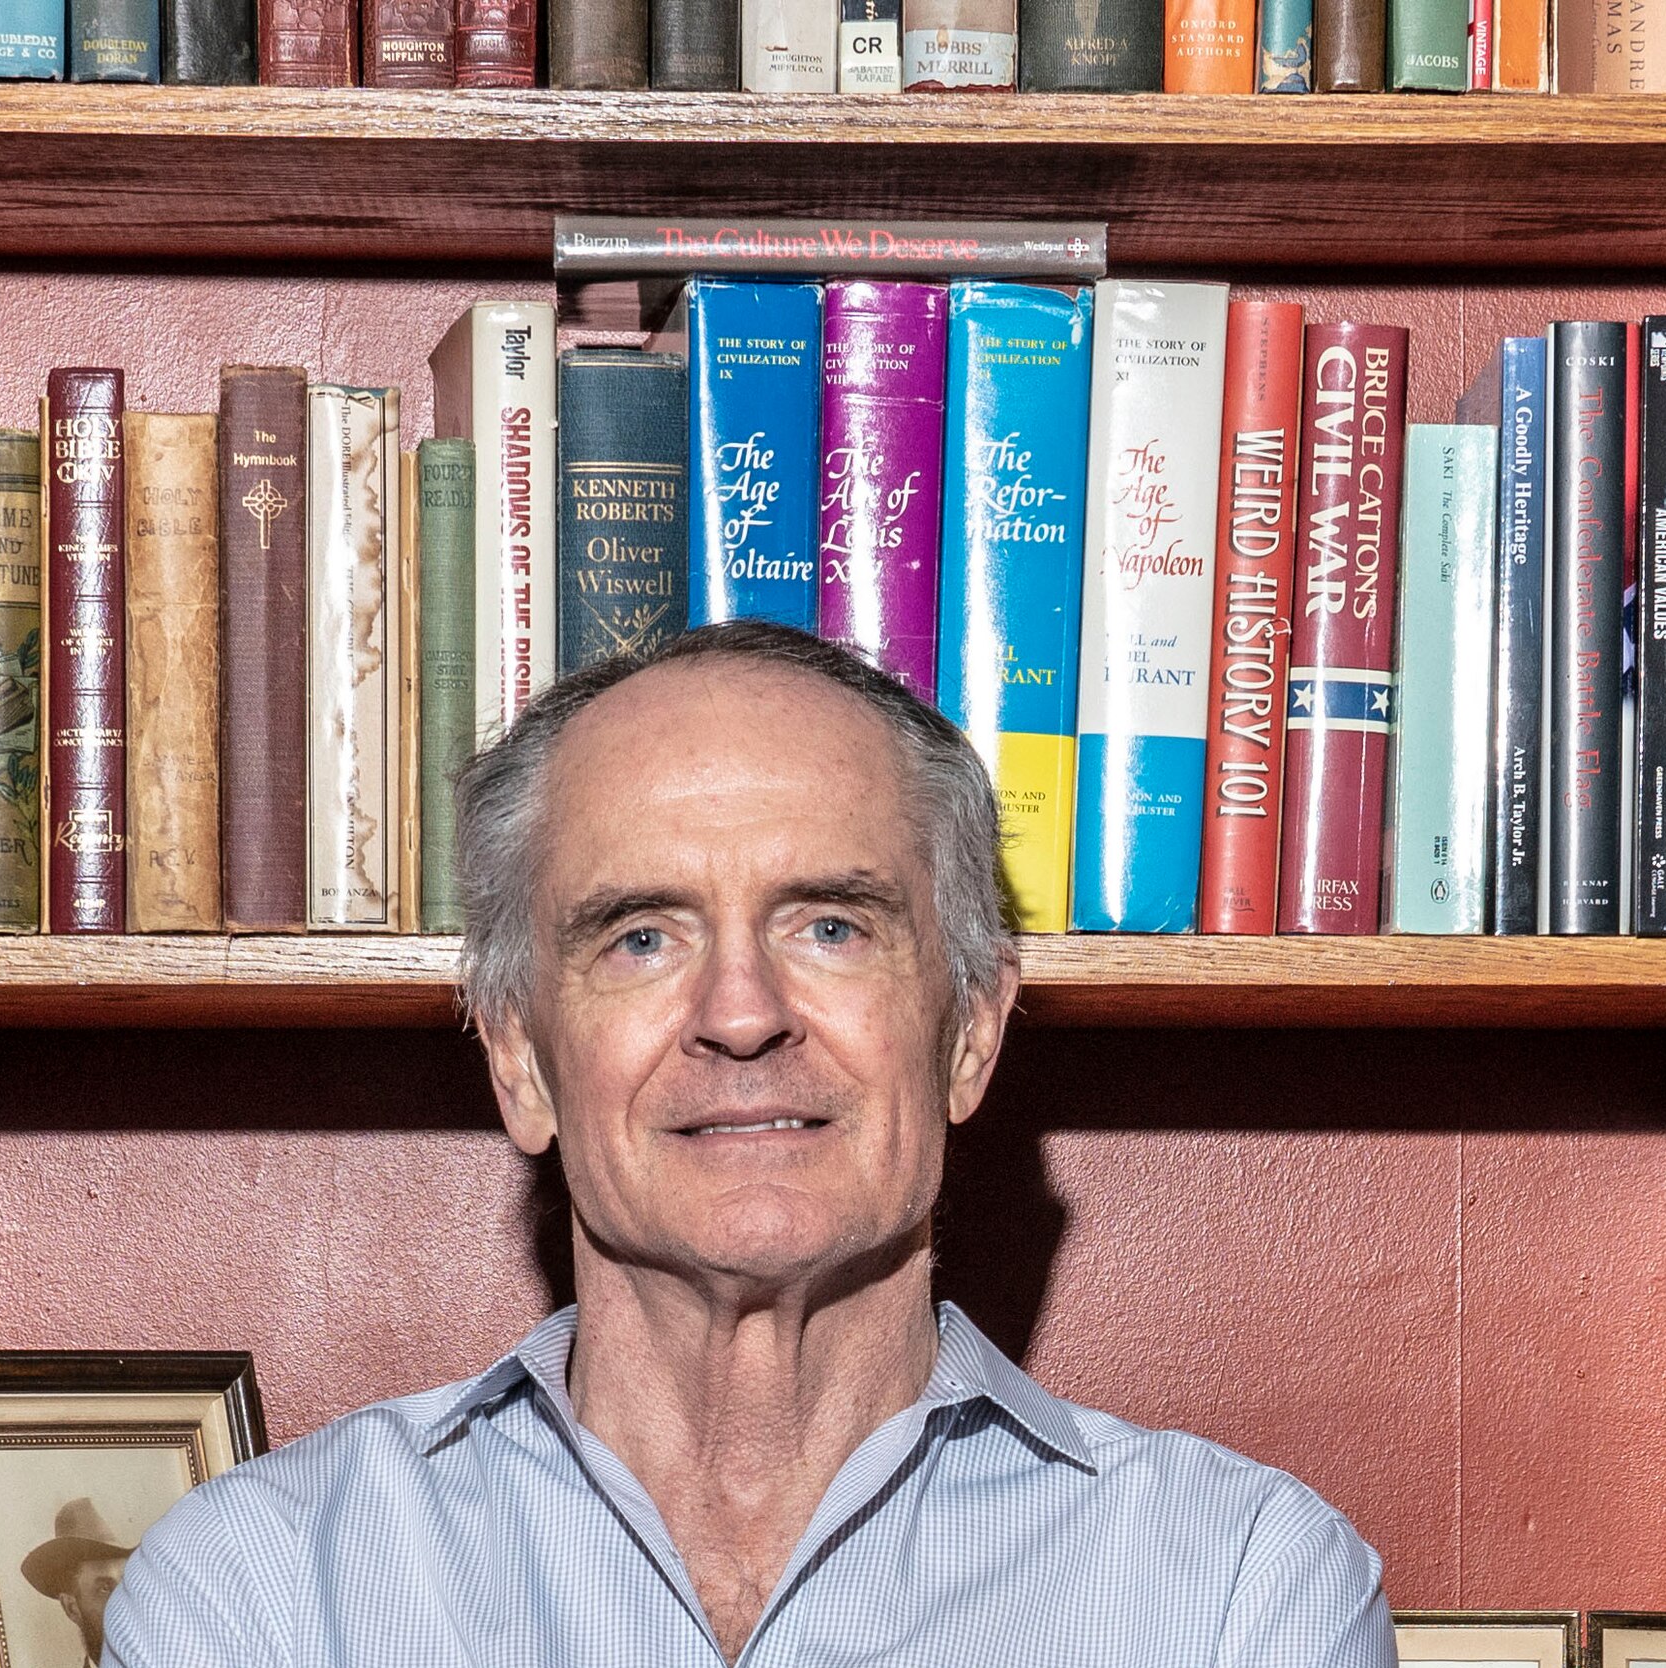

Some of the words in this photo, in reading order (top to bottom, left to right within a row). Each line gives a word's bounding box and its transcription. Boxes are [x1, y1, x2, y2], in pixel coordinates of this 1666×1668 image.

[1181, 21, 1235, 29] OXFORD
[383, 41, 445, 55] HOUGHTON
[853, 37, 881, 54] CR
[1170, 34, 1243, 44] STANDARD
[1476, 20, 1488, 75] VINTAGE
[22, 47, 30, 57] &
[38, 49, 55, 58] CO.
[383, 52, 423, 61] MIFFLIN
[430, 53, 446, 62] CO.
[1178, 47, 1240, 56] AUTHORS
[1406, 55, 1459, 68] JACOBS
[574, 233, 629, 251] Barzun
[658, 227, 707, 259] The
[713, 229, 816, 260] Culture
[819, 227, 861, 260] We
[867, 229, 979, 261] Deserve
[501, 325, 531, 380] Taylor
[718, 338, 741, 347] THE
[747, 339, 785, 349] STORY
[791, 341, 806, 350] OF
[717, 354, 800, 365] CIVILIZATION
[1362, 347, 1389, 456] BRUCE
[1516, 385, 1531, 401] A
[1312, 346, 1357, 496] CIVIL
[254, 430, 276, 443] The
[1512, 407, 1532, 476] Goodly
[234, 453, 296, 468] Hymnbook
[574, 479, 673, 498] KENNETH
[1233, 429, 1284, 556] WEIRD
[577, 502, 673, 520] ROBERTS
[1510, 482, 1532, 565] Heritage
[587, 537, 664, 564] Oliver
[1306, 502, 1350, 617] WAR
[577, 570, 671, 594] Wiswell
[1221, 570, 1279, 748] HISTORY
[1219, 760, 1270, 818] 101
